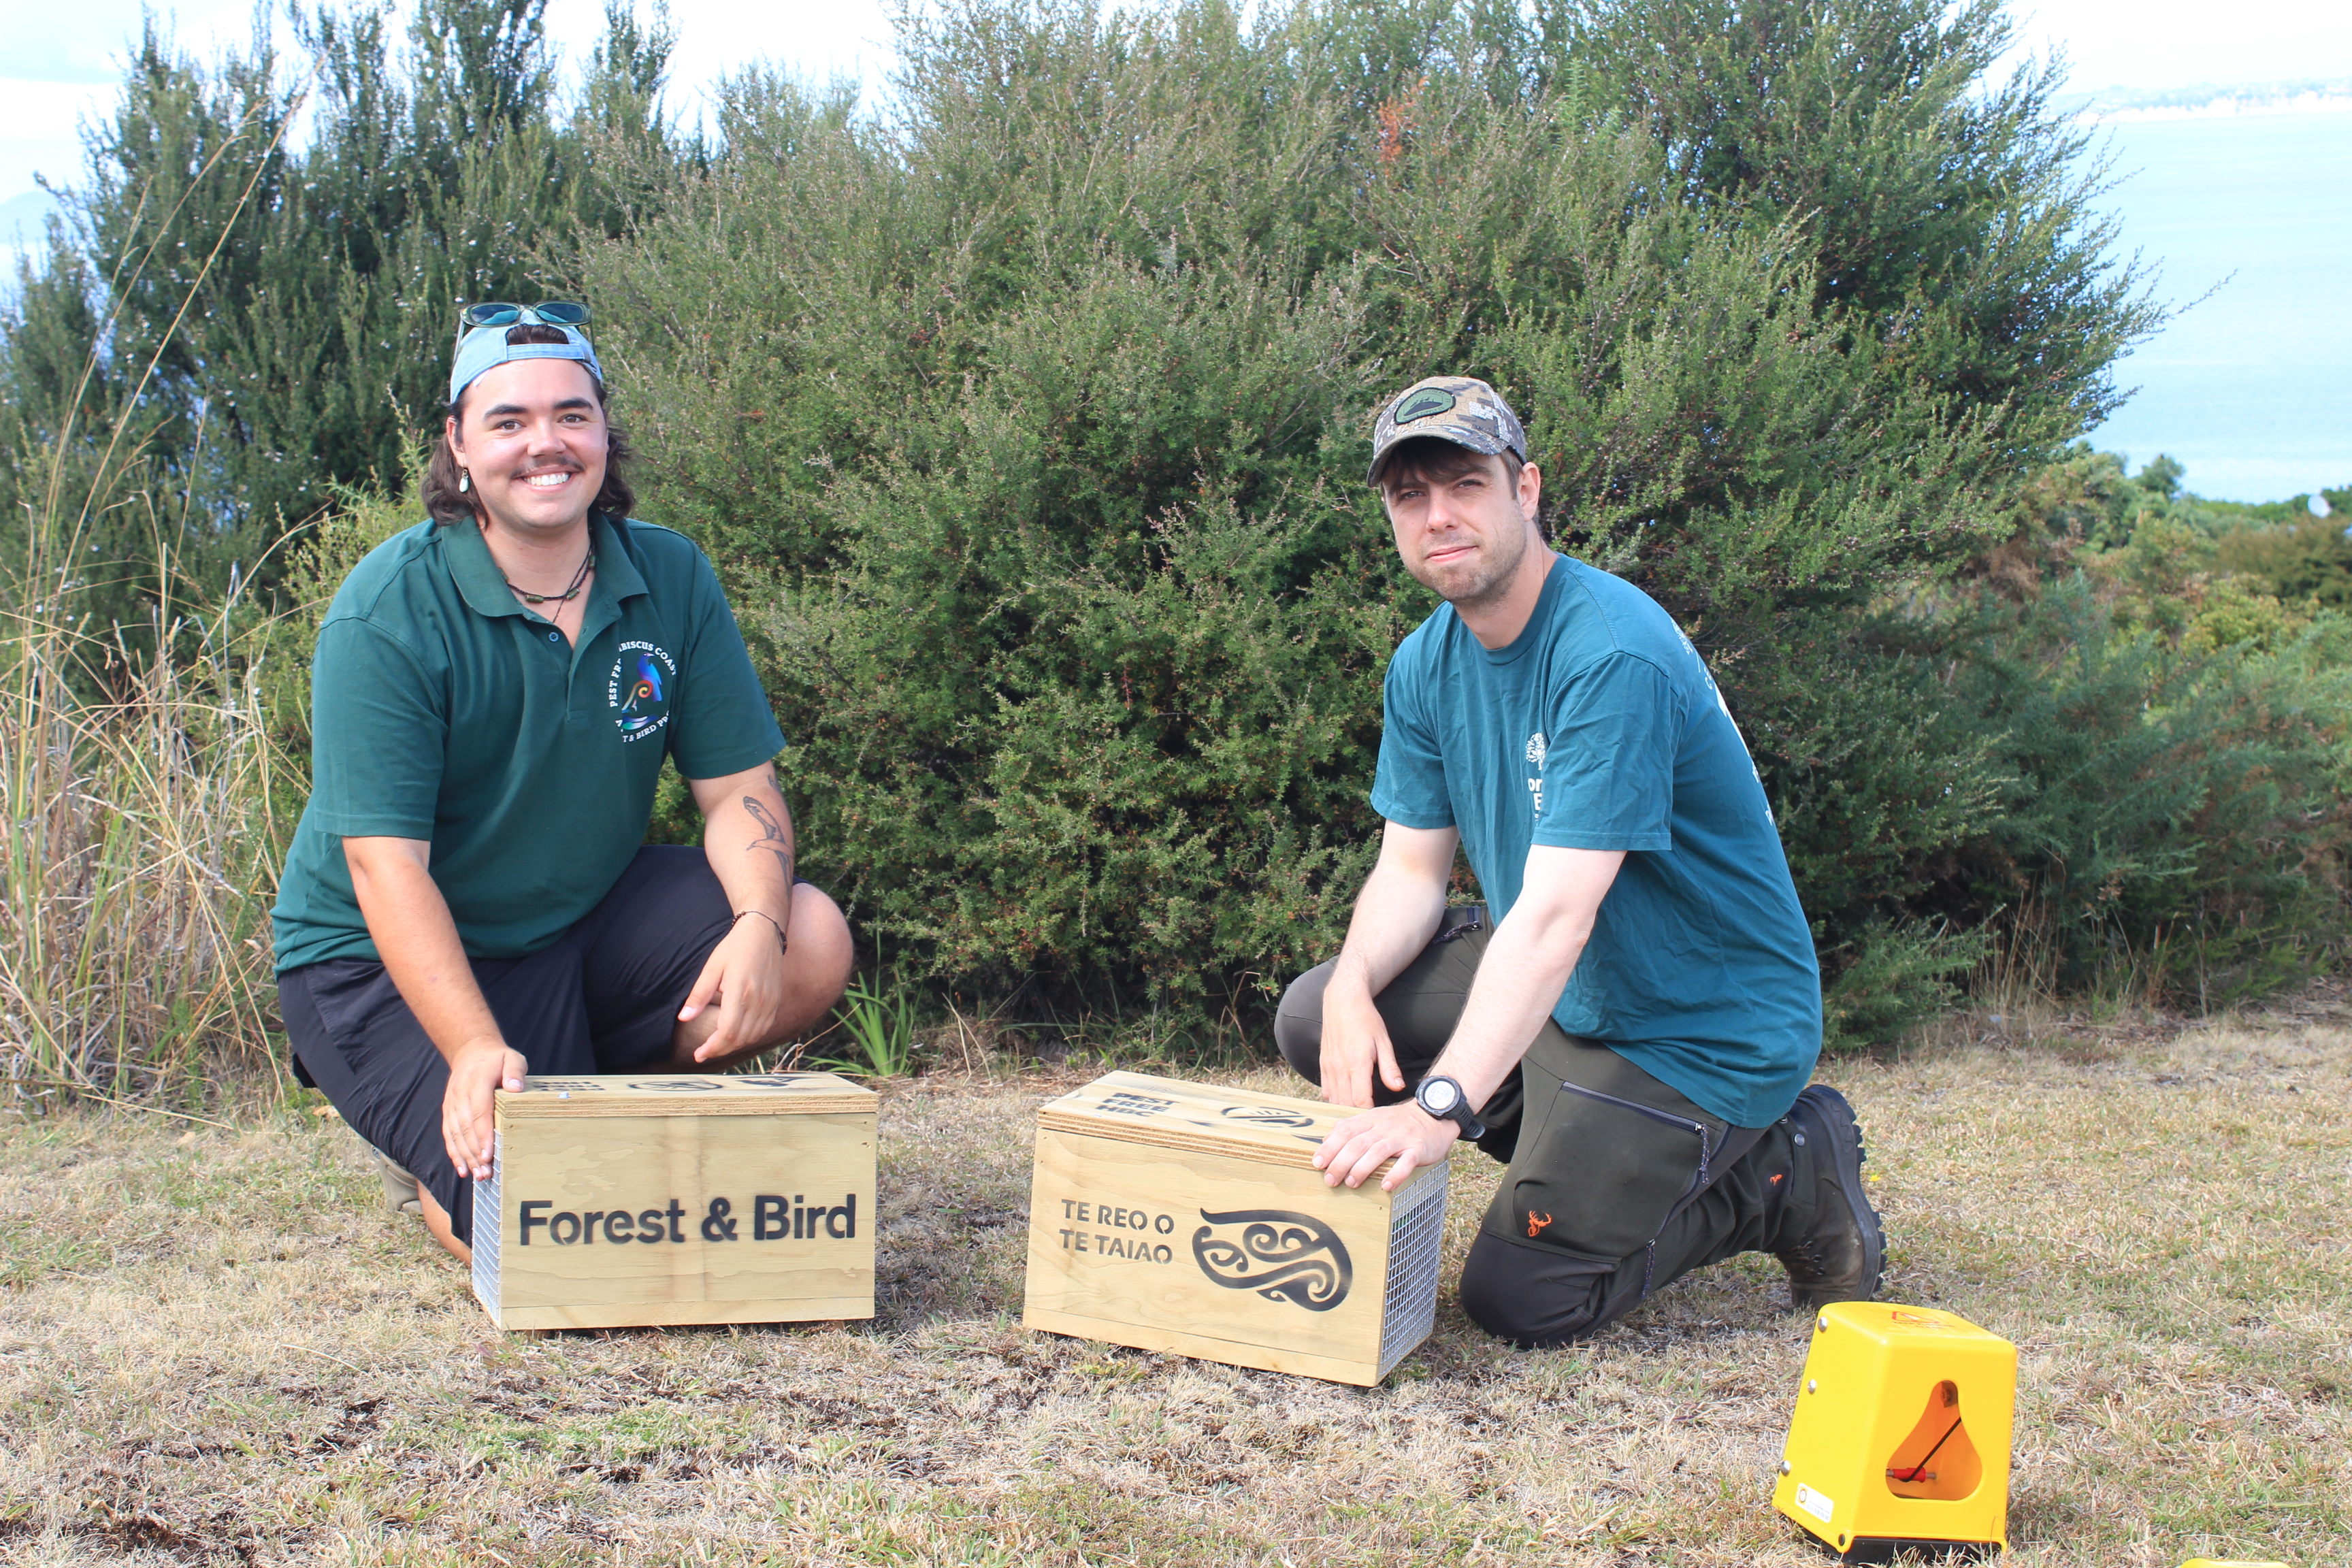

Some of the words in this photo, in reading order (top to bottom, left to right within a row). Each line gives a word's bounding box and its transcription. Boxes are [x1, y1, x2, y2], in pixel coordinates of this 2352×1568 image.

[608, 681, 618, 707] PEST
[655, 647, 676, 676] COAST
[636, 725, 657, 740] BIRD
[1095, 1105, 1155, 1117] HBC
[1102, 1098, 1169, 1111] FREE
[1112, 1092, 1181, 1105] PEST
[519, 1198, 685, 1246] Forest
[701, 1196, 738, 1242] &
[753, 1194, 856, 1241] Bird
[1061, 1198, 1090, 1222] TE
[1097, 1205, 1148, 1230] REO
[1154, 1214, 1175, 1235] O
[1059, 1228, 1088, 1252] TE
[1094, 1234, 1173, 1265] TAIAO
